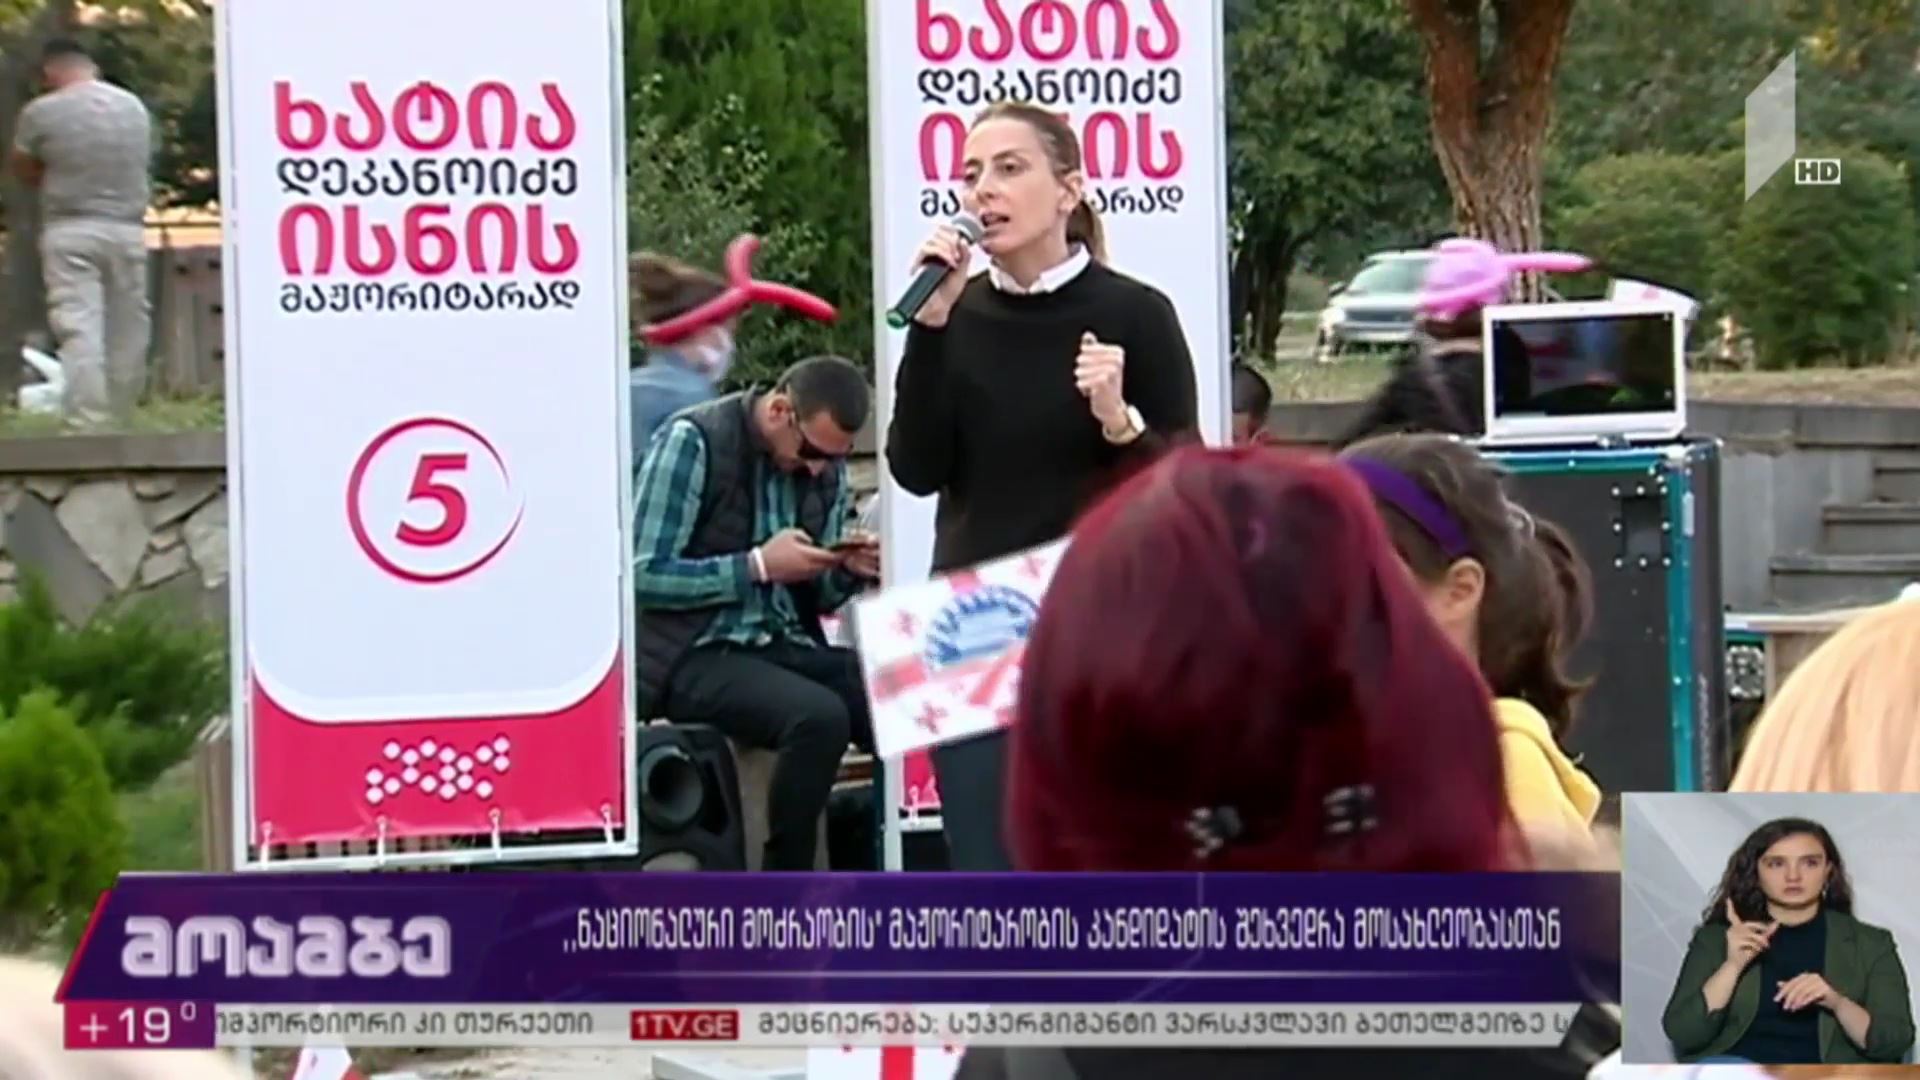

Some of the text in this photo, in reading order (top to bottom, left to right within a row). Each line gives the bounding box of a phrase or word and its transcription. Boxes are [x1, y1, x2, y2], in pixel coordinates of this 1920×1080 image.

[915, 0, 1180, 62] ხატია
[274, 81, 576, 151] ხატია
[918, 68, 1182, 105] დეკანოიძე
[277, 158, 578, 196] დეკანოიძე
[919, 111, 1183, 181] იის
[920, 186, 1184, 216] მაარად
[279, 203, 580, 276] ისნის
[280, 281, 580, 313] მაჟორიტარად
[395, 453, 468, 547] 5
